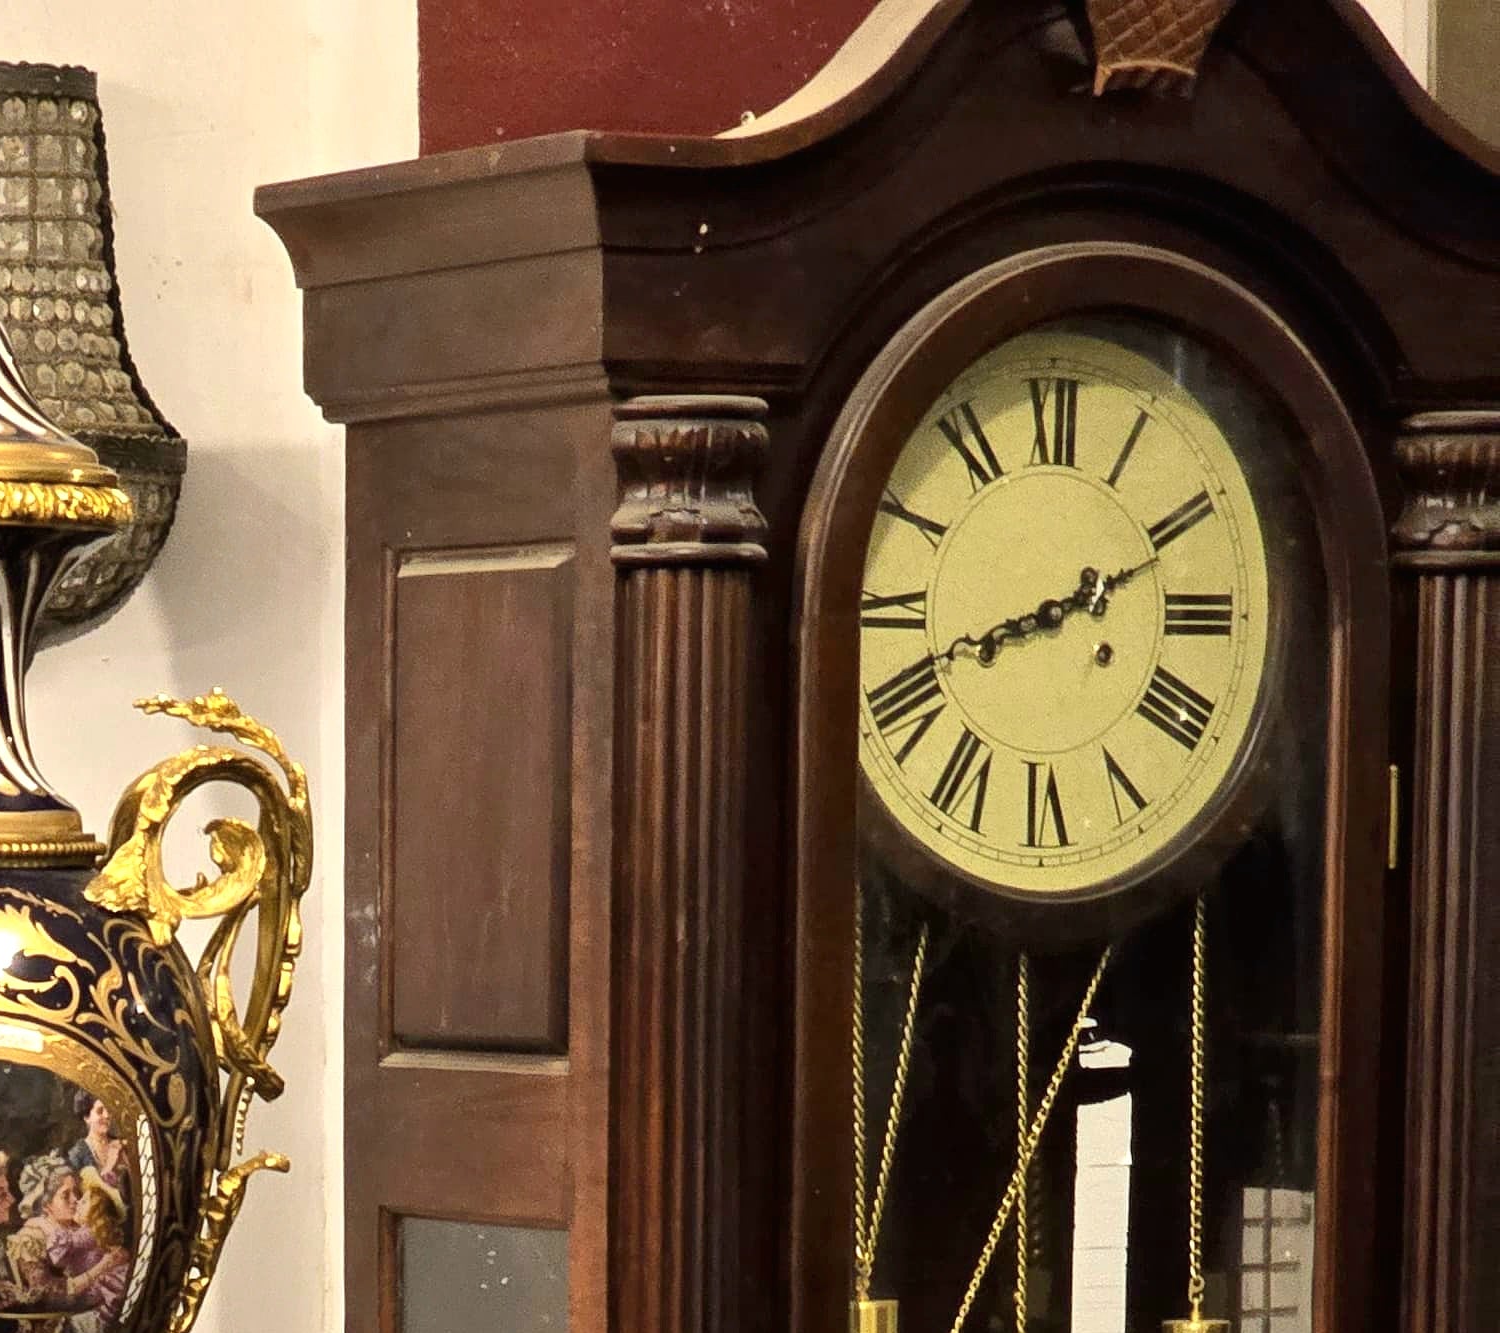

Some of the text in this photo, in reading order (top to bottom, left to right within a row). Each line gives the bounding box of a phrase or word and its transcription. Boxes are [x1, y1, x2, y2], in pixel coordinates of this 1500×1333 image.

[936, 399, 1011, 499] XI
[1021, 377, 1083, 471] XII
[1099, 404, 1157, 493] I
[878, 487, 953, 556] X
[1141, 480, 1219, 552] II
[861, 581, 929, 639] IX
[1162, 586, 1233, 642] III
[863, 648, 948, 775] VIII
[1131, 664, 1218, 767] IIII
[920, 720, 995, 838] VII
[1018, 759, 1079, 848] VI
[1101, 744, 1156, 831] V
